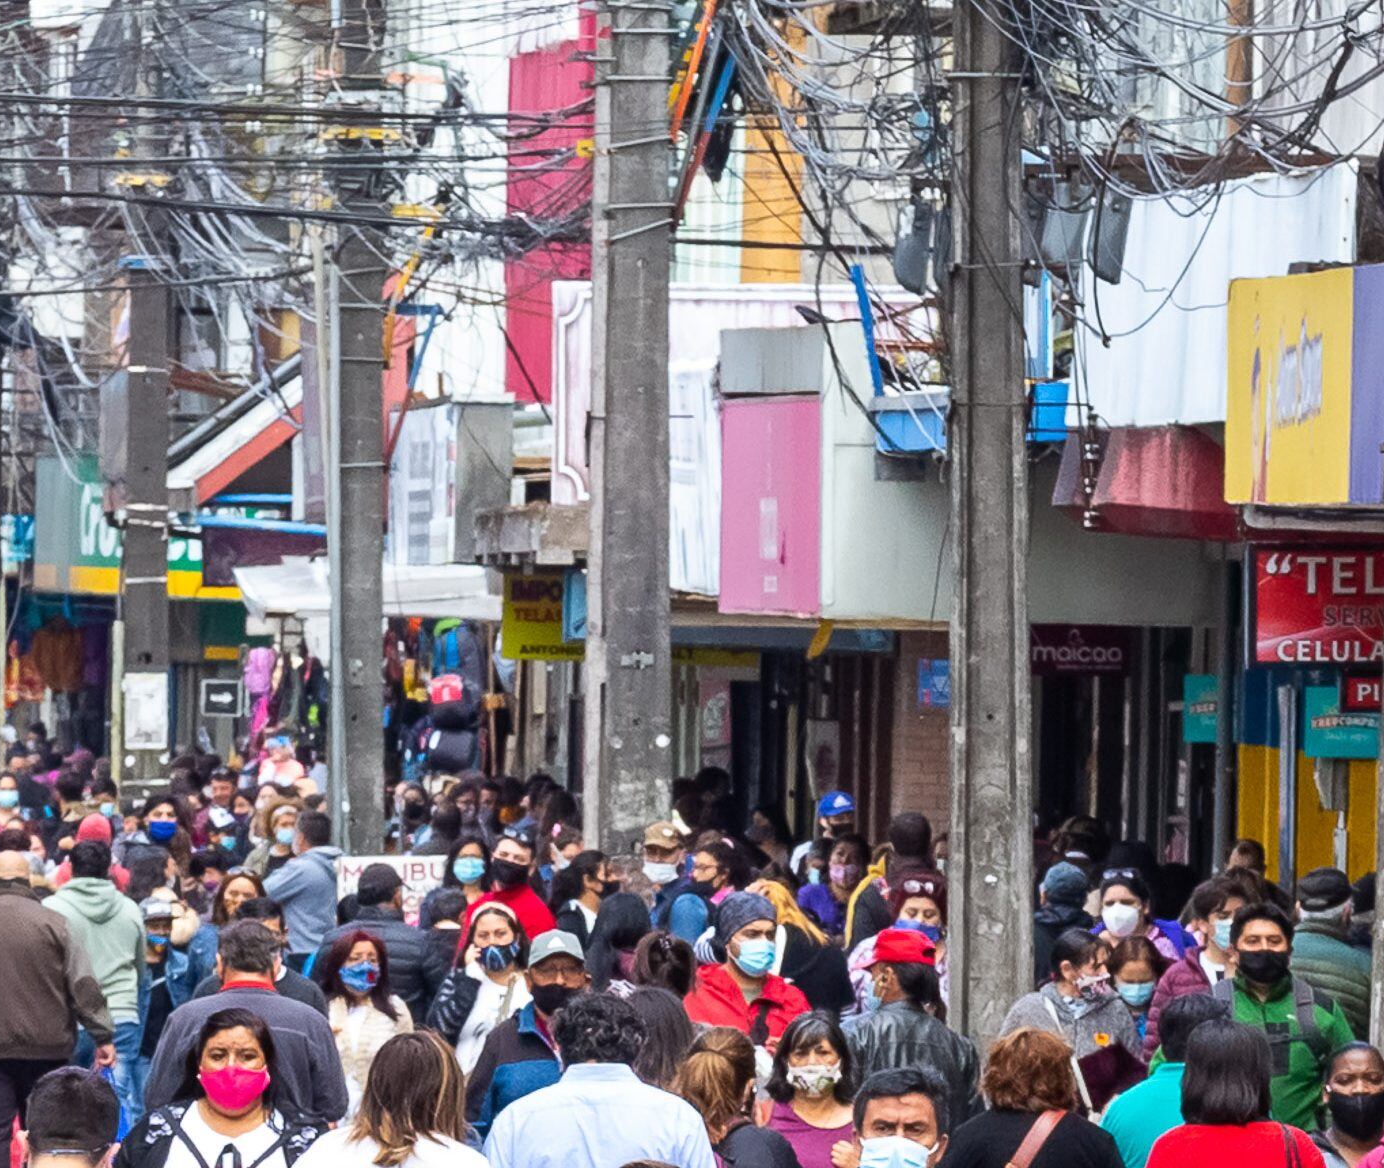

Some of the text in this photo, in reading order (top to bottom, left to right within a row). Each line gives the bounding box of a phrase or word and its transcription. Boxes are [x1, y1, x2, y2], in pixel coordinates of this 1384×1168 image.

[512, 579, 563, 602] IMPO
[513, 607, 562, 623] TELA
[1324, 606, 1384, 627] SERV
[1032, 646, 1123, 663] maicao
[1276, 640, 1384, 662] CELULA
